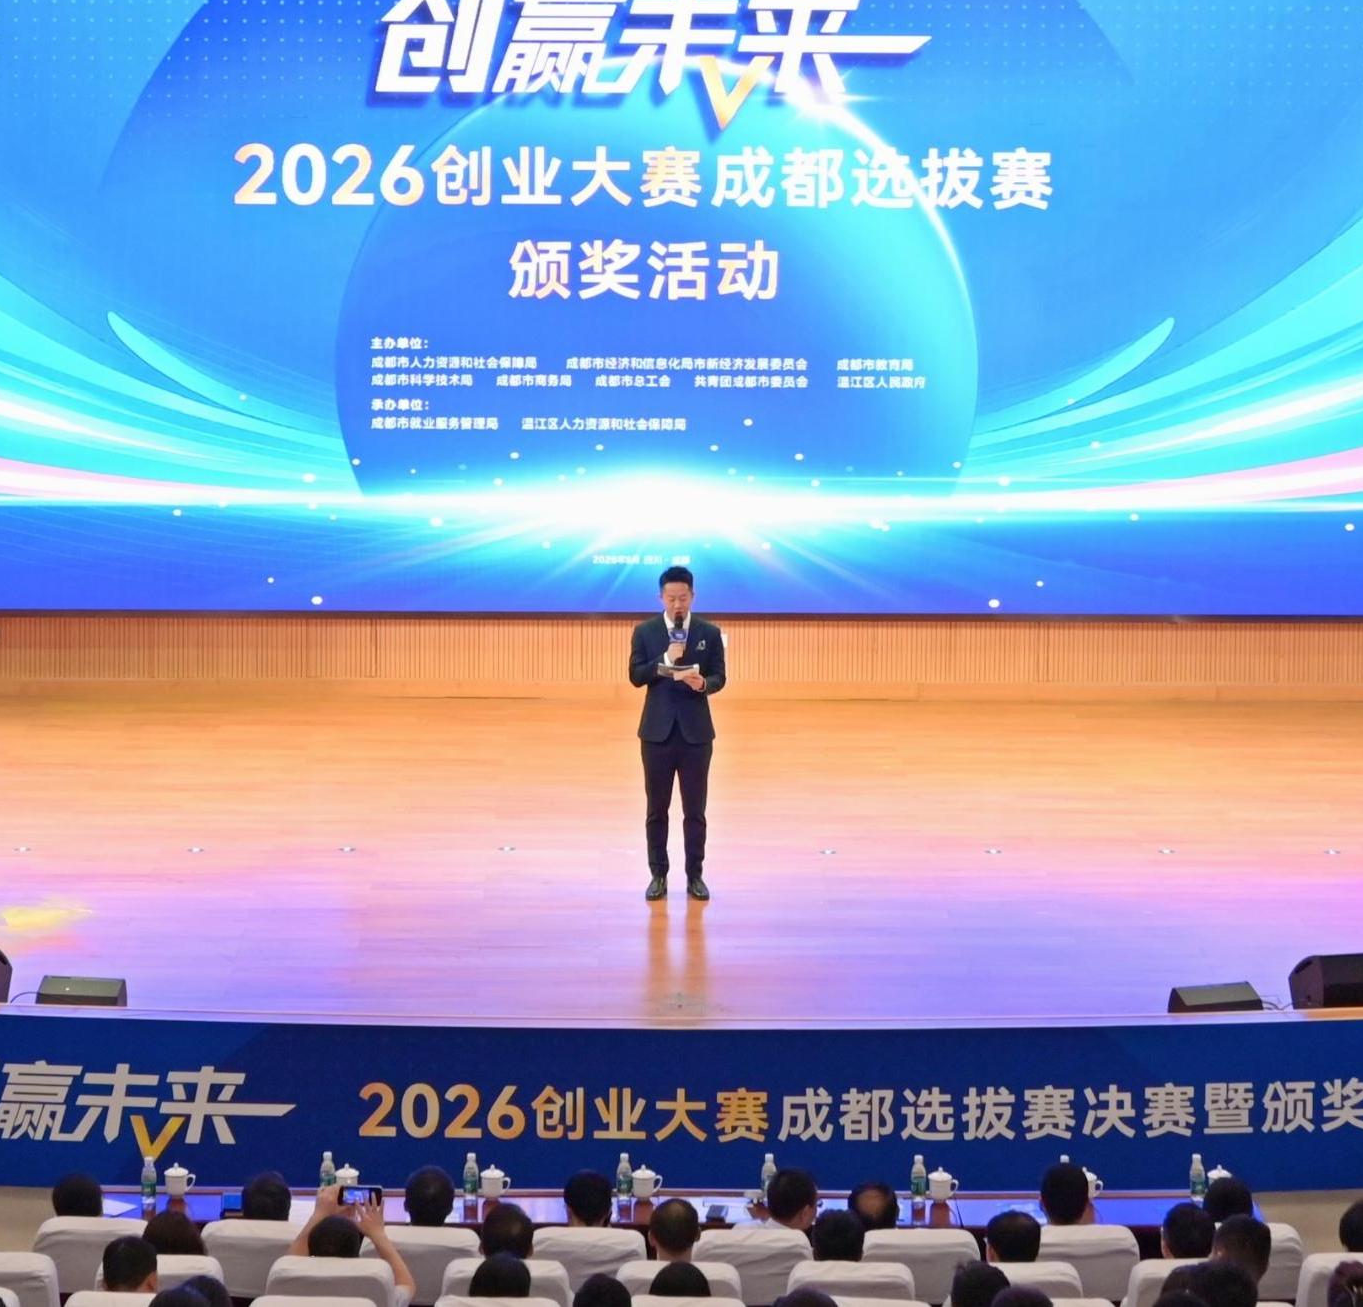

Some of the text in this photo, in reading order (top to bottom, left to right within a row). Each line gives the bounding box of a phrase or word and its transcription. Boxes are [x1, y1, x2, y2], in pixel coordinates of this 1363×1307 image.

[232, 143, 1052, 212] 2026创业大赛成都选拔赛
[509, 240, 779, 300] 颁奖活动
[371, 356, 537, 369] 成都市人力资源和社会保障局
[837, 358, 914, 371] 成都市教育局
[371, 374, 926, 389] 成都市科学技术局 成都市商务局 成都市总工会 共青团成都市委员会 温江区人民政府
[371, 417, 687, 431] 成都市就业服务管理局 温江区人力资源和社会保障局
